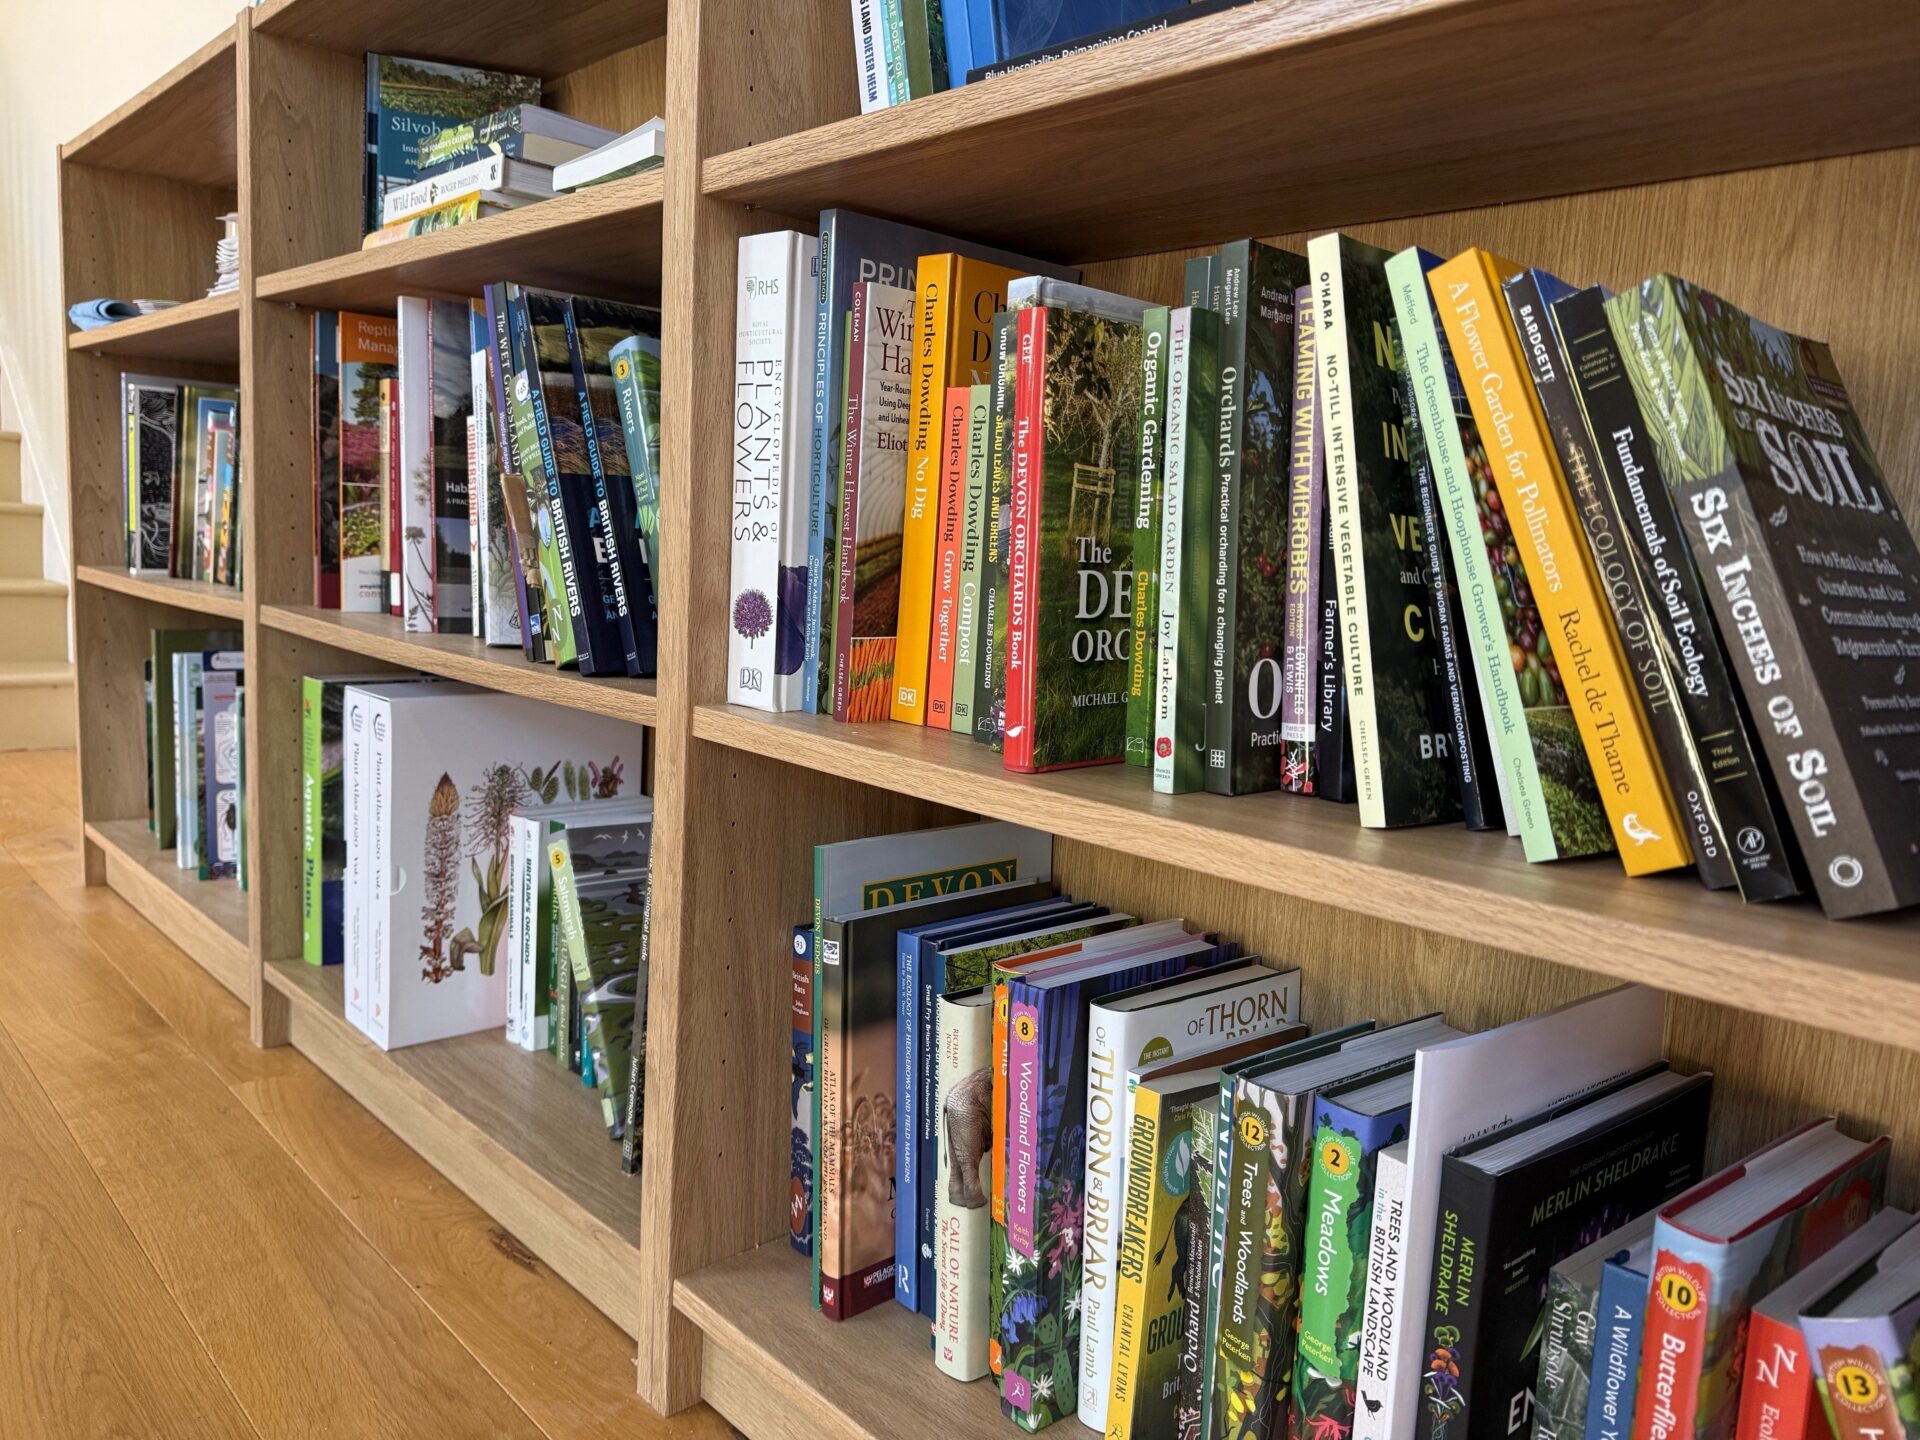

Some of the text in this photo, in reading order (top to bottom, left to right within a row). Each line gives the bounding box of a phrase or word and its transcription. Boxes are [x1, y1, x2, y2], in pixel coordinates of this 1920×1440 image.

[860, 4, 878, 103] LAND DIETER HELM
[393, 193, 410, 212] Wild
[410, 186, 427, 208] Food
[497, 312, 505, 334] The
[758, 278, 779, 296] RHS
[854, 291, 862, 342] COLEMAN
[499, 337, 510, 368] WET
[1519, 304, 1556, 384] BARDGETT
[622, 387, 636, 435] Rivers
[811, 312, 827, 538] PRINCIPLES OF HORTICULTURE
[911, 283, 938, 519] Charles Dowding No Dig
[1136, 331, 1162, 530] Organic Gardening
[1219, 366, 1237, 468] Orchards
[1290, 297, 1315, 594] TEAMING WITH MICROBES
[734, 361, 755, 542] FLOWERS
[752, 359, 774, 543] PLANTS &
[770, 359, 783, 544] ENCYCLOPEDIA OF
[840, 393, 859, 604] The Winter Harvest Handbook
[1219, 474, 1231, 523] Practical
[1320, 272, 1364, 697] O'HARA NO-TILL INTENSIVE VEGETABLE CULTURE
[1612, 425, 1668, 557] Fundamentals
[532, 389, 581, 617] A FIELD GUIDE TO BRITISH RIVERS
[938, 405, 964, 664] Charles Dowding Grow Together
[958, 405, 987, 665] Charles Dowding Compost
[1011, 416, 1029, 671] The DEVON ORCHARDS Book
[1161, 325, 1184, 720] THE ORGANIC SALAD GARDEN Joy Larkcom
[1402, 284, 1515, 736] Mefferd The Greenhouse and Hoophouse Grower's Handbook
[1448, 281, 1632, 796] A Flower Garden for Pollinators Rachel de Thame
[1216, 525, 1228, 588] orcharding
[1218, 588, 1231, 605] for
[1584, 501, 1638, 612] ECOLOGY
[1654, 557, 1679, 579] of
[1663, 575, 1687, 620] Soil
[1131, 570, 1149, 697] Charles Dowding
[1214, 616, 1227, 668] changing
[1321, 600, 1337, 732] Farmer's Library
[1418, 466, 1472, 783] THE BEGINNER'S GUIDE TO WORM FARMS AND VERMICOMPOSTING
[1626, 621, 1651, 652] OF
[1673, 614, 1709, 697] Ecology
[1214, 669, 1225, 704] planet
[1638, 657, 1670, 714] SOIL
[1687, 790, 1718, 858] OXFORD
[524, 858, 533, 965] BRITAIN'S ORCHIDS
[557, 876, 578, 940] Saltmarsh
[814, 935, 822, 975] HEDGES
[906, 1019, 912, 1032] OF
[1021, 1021, 1029, 1036] 8
[627, 1056, 639, 1124] Julian Cremona
[1017, 1061, 1034, 1214] Woodland Flowers
[1245, 1122, 1260, 1141] 12
[1085, 1026, 1117, 1380] OF THORN & BRIAR Paul Lamb
[1242, 1162, 1259, 1207] Trees
[1330, 1149, 1341, 1168] 2
[948, 1216, 961, 1344] CALL OF NATURE
[1115, 1113, 1156, 1402] GROUNDBREAKERS CHANTAL LYONS
[1233, 1231, 1253, 1325] Woodlands
[1316, 1188, 1343, 1297] Meadows
[1363, 1187, 1386, 1378] in the BRITISH LANDSCAPE
[1377, 1199, 1403, 1382] TREES AND WOODLAND
[1435, 1210, 1459, 1316] SHELDRAKE
[1456, 1236, 1476, 1307] MERLIN
[1183, 1296, 1201, 1373] Orchard
[1569, 1310, 1597, 1346] Guy
[1666, 1279, 1692, 1307] 10
[1545, 1298, 1573, 1389] Shrubsole
[1603, 1305, 1633, 1426] A Wildflower
[1651, 1332, 1687, 1440] Butterflie
[1842, 1374, 1871, 1396] 13
